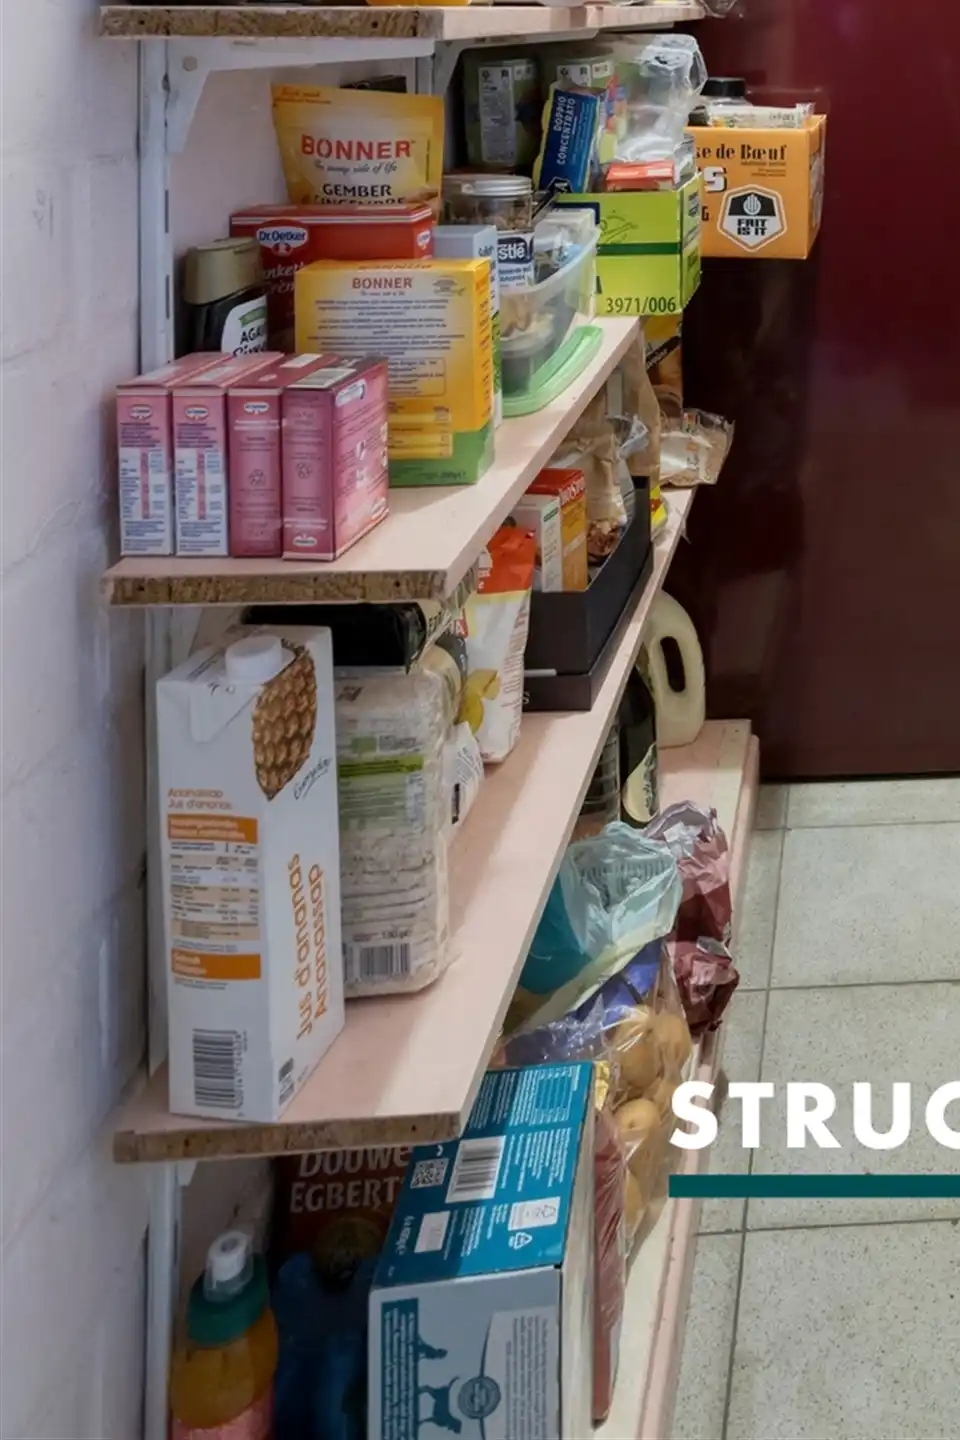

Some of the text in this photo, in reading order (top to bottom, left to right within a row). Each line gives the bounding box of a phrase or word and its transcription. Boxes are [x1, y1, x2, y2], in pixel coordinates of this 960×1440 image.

[556, 97, 576, 165] CONCENTRATO
[301, 134, 411, 161] BONNER
[716, 144, 735, 160] de
[322, 183, 392, 197] GEMBER
[737, 218, 769, 228] FRIT
[352, 277, 413, 289] BONNER
[606, 296, 677, 314] 3971/006
[287, 853, 313, 1041] Jus d'ananas
[307, 863, 327, 1020] Ananassap
[290, 1175, 400, 1214] EGBERT
